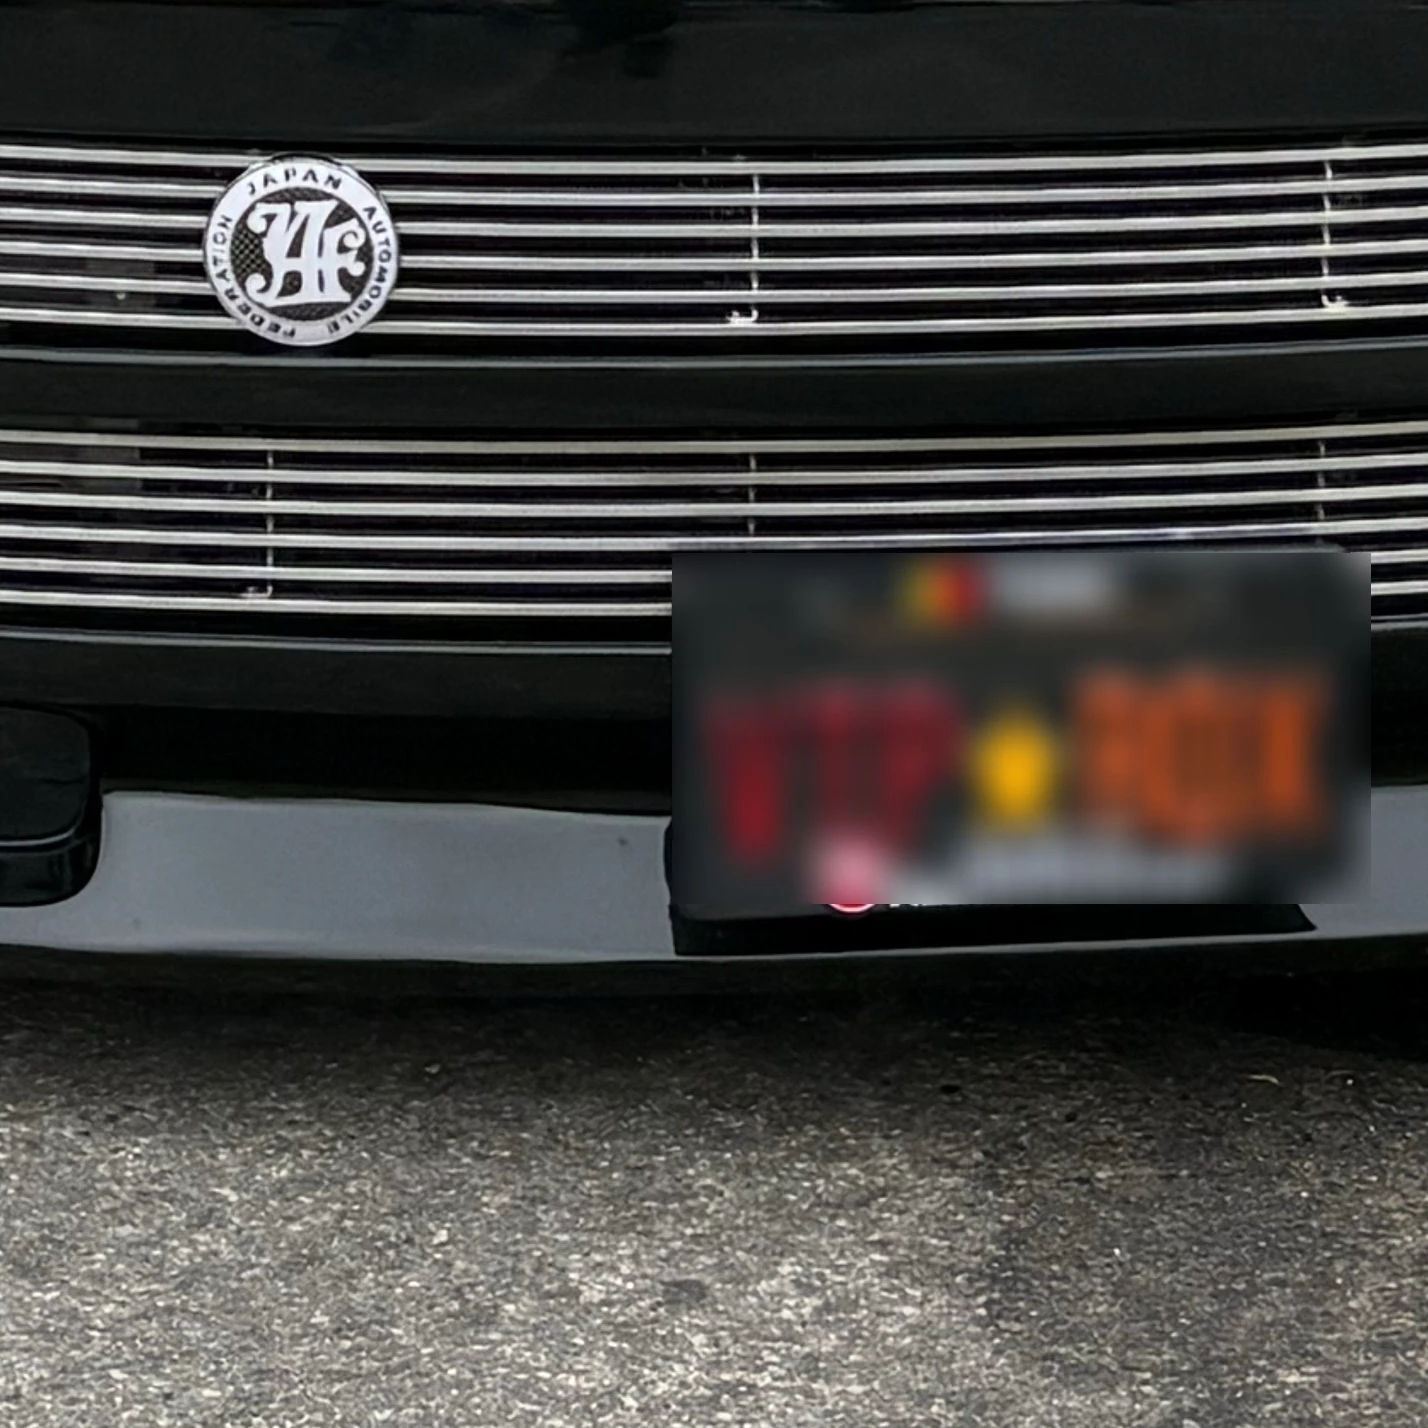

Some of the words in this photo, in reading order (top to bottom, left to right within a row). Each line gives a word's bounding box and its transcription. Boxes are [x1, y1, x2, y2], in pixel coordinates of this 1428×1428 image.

[247, 167, 343, 196] JAPAN
[211, 214, 297, 339] FEDERATION
[325, 205, 393, 335] AUTOMOBILE
